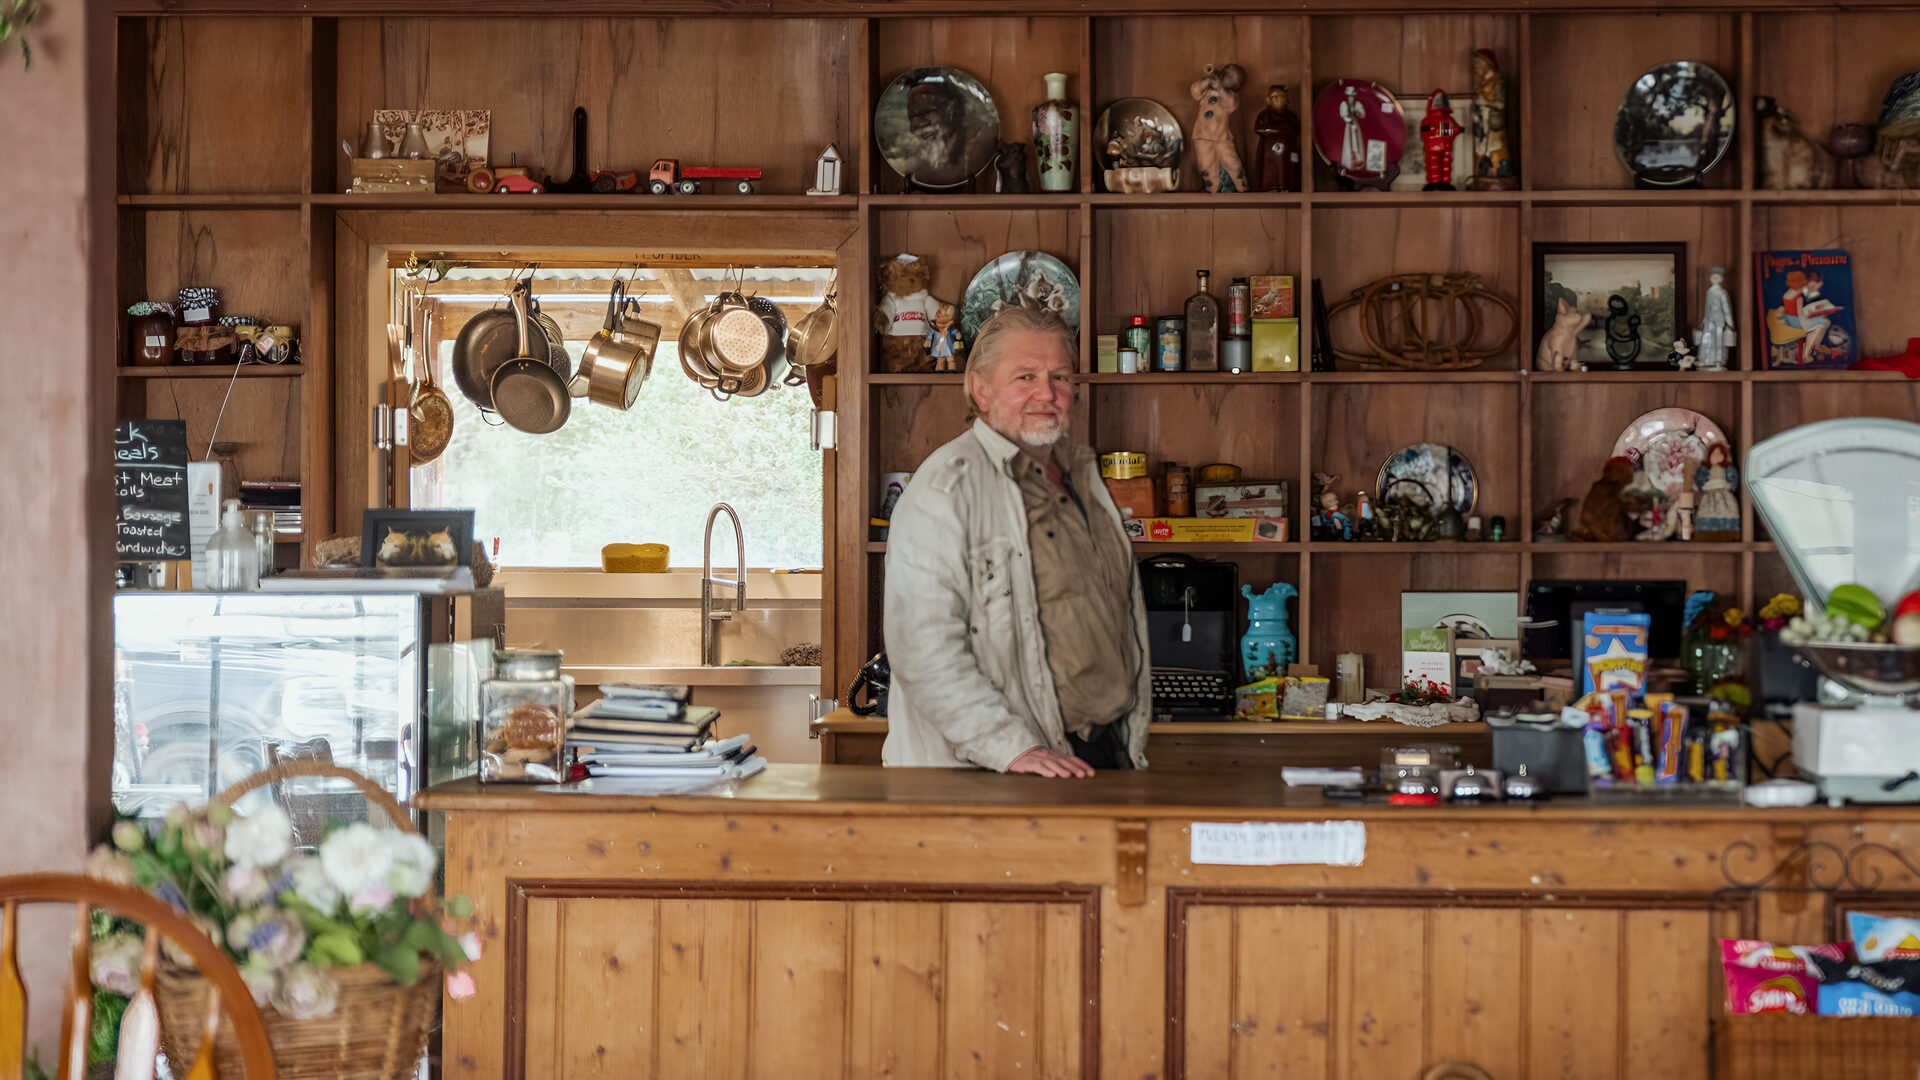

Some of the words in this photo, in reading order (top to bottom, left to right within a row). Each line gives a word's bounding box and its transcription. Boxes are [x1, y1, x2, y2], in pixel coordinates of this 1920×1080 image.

[113, 442, 159, 461] eals
[140, 471, 183, 486] Meat
[122, 506, 183, 527] Sausage
[115, 522, 164, 537] Toasted
